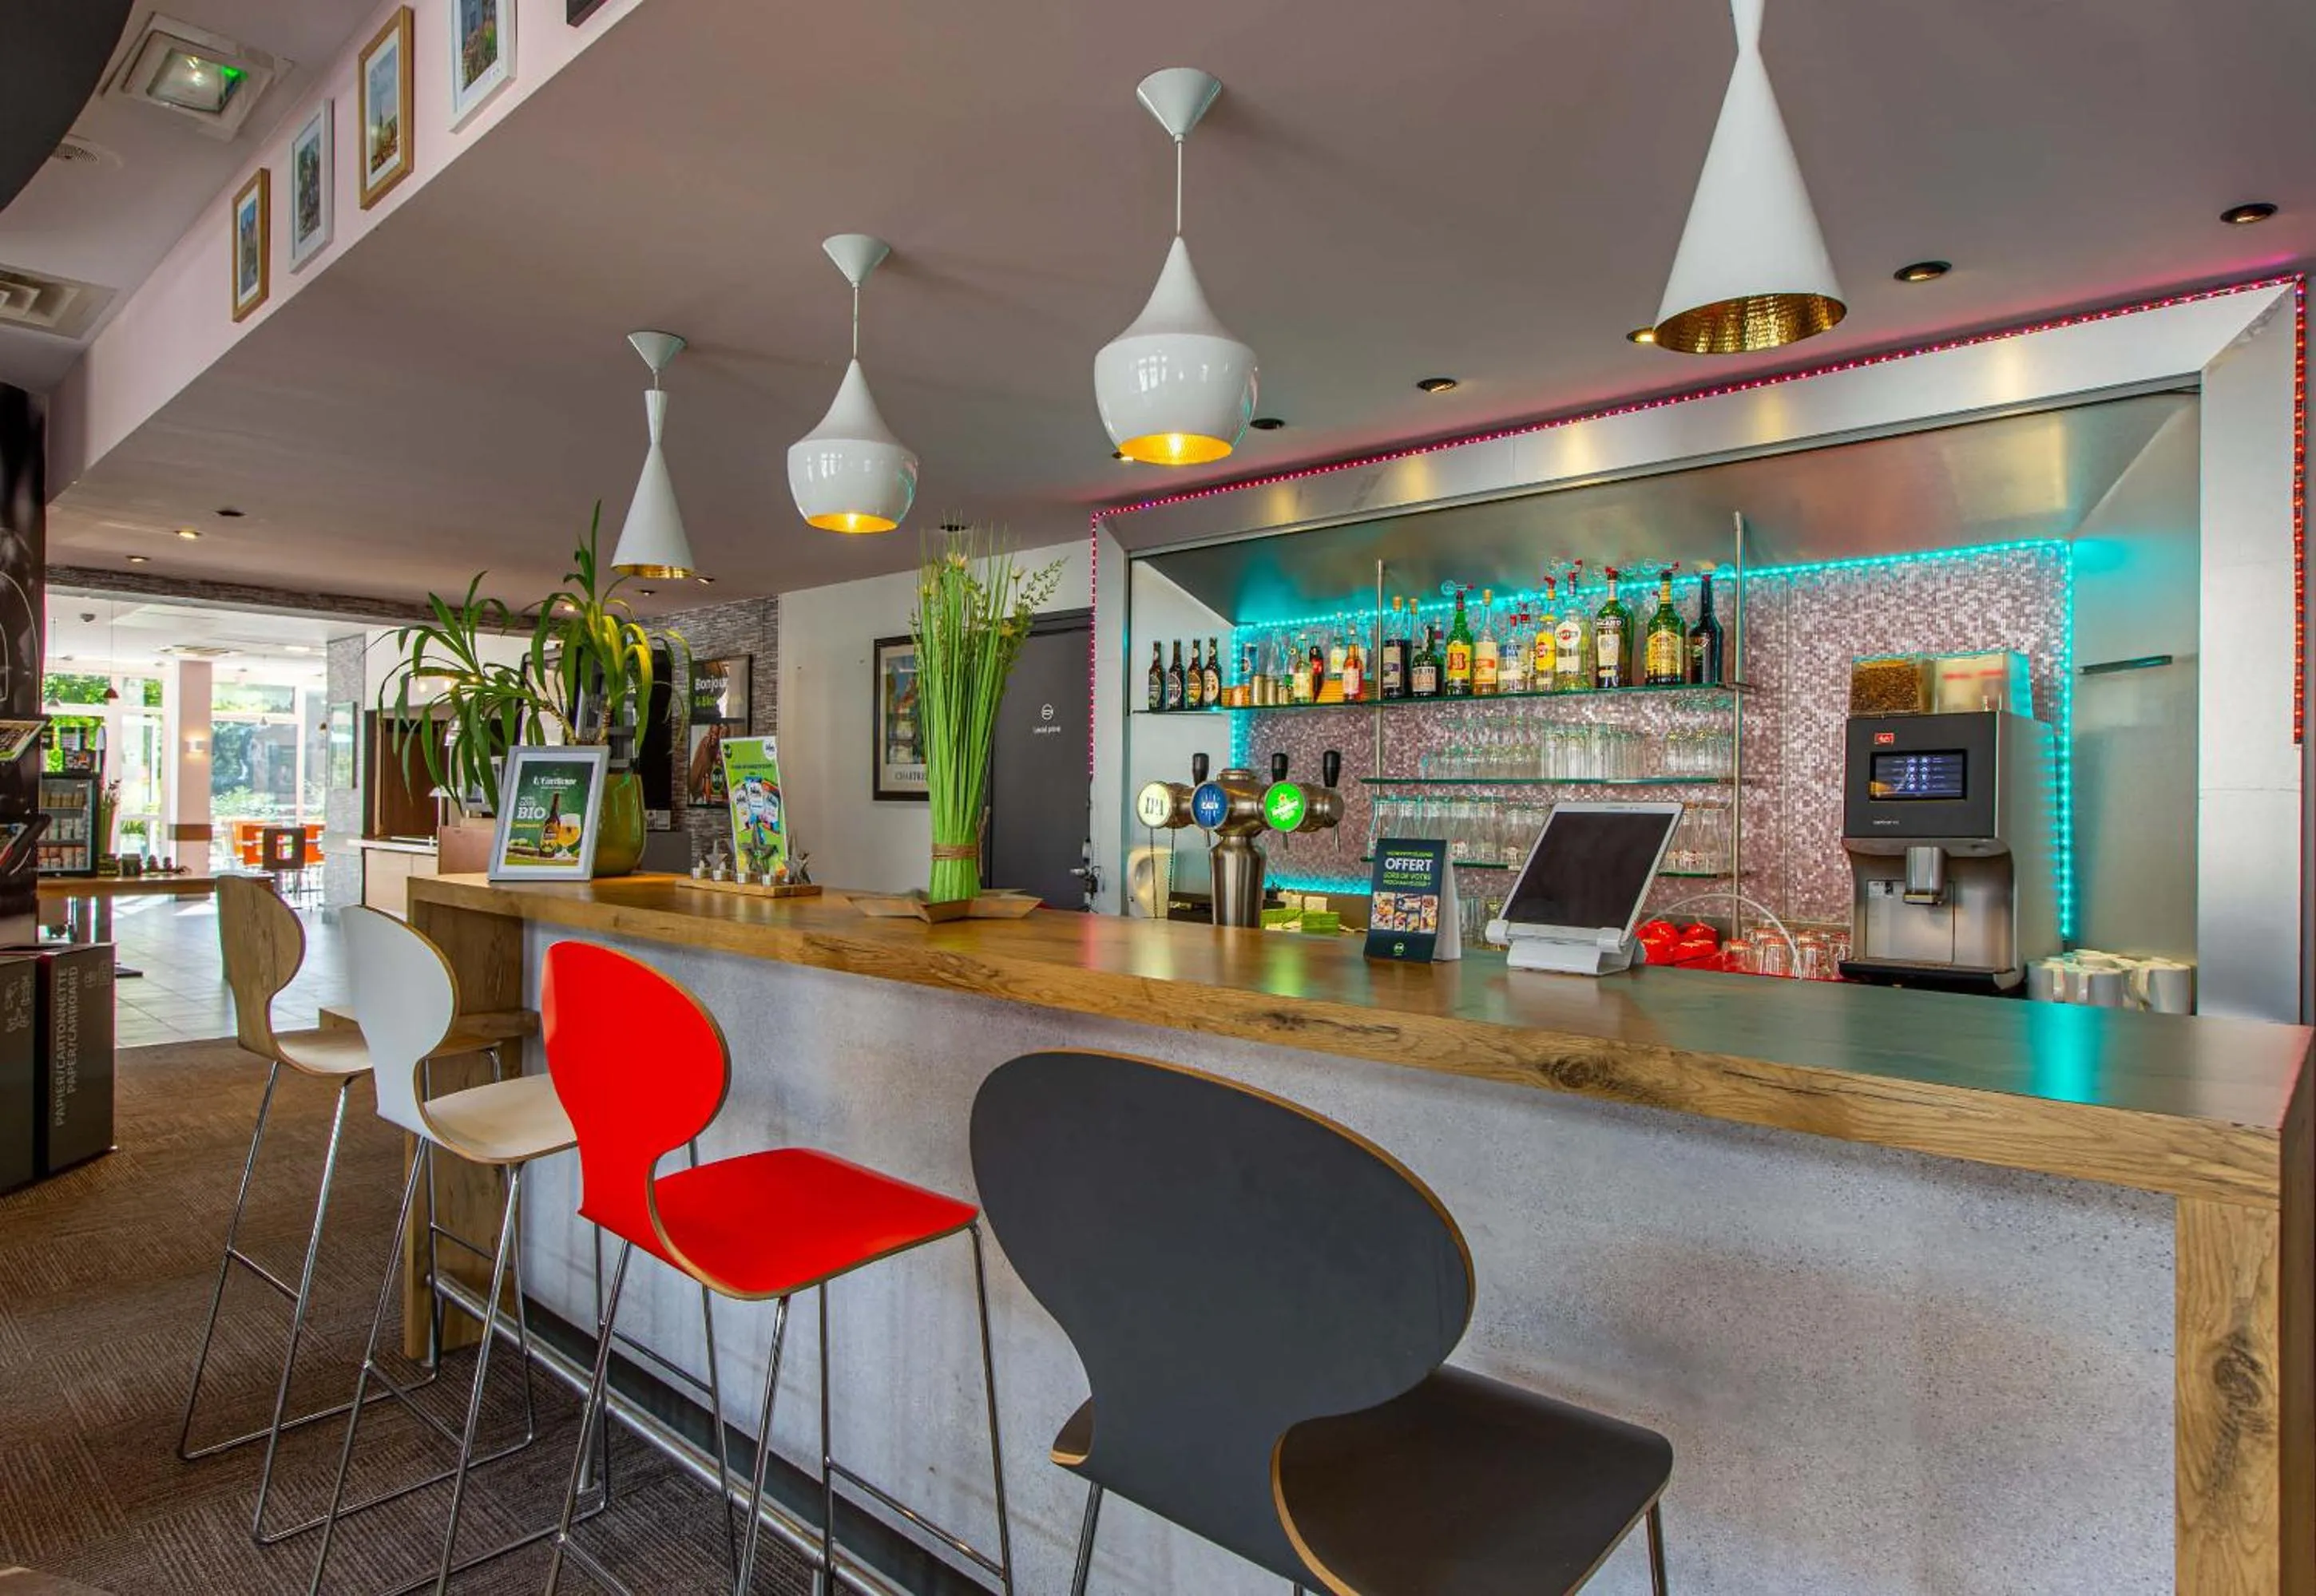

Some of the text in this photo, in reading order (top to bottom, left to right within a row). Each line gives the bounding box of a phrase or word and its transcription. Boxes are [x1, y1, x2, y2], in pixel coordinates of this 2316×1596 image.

[517, 806, 545, 819] BIO
[1385, 857, 1433, 872] OFFERT
[55, 968, 68, 1127] PAPIER/CARTONNETTE
